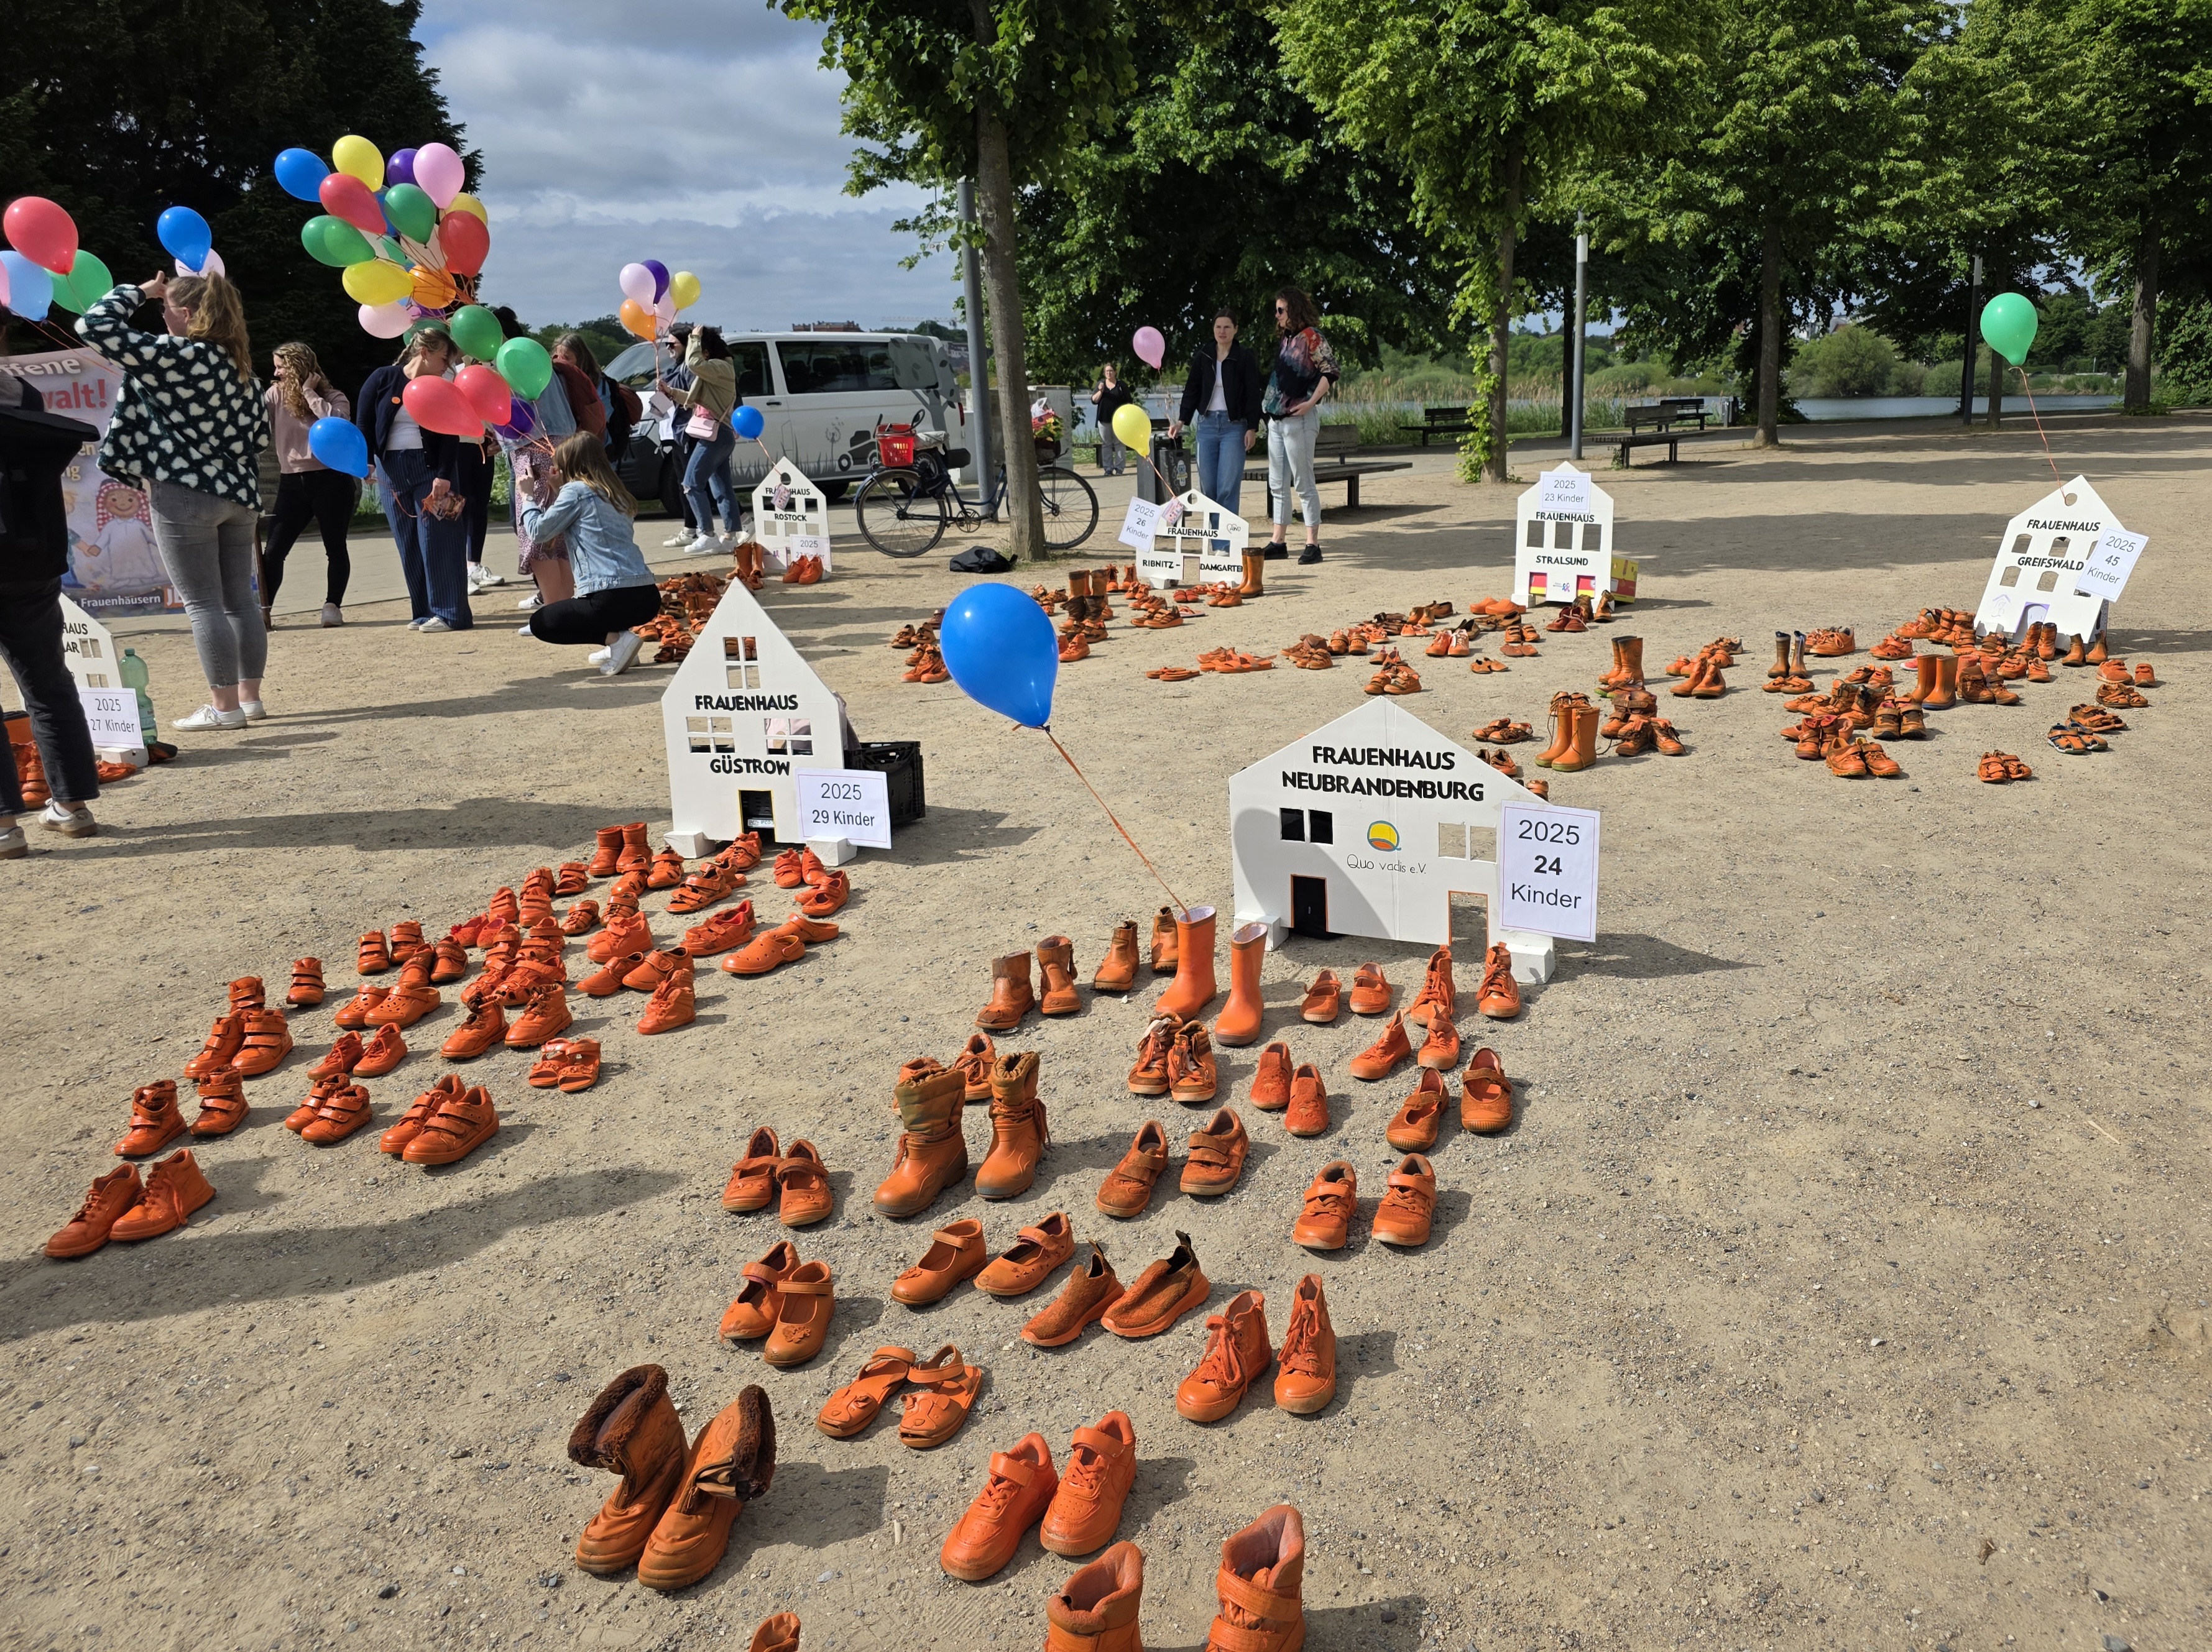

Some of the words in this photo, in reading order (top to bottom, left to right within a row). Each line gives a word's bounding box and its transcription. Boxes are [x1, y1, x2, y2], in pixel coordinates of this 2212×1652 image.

[1554, 480, 1575, 489] 2025
[1557, 494, 1584, 502] Kinder
[775, 513, 807, 521] ROSTOCK
[1135, 504, 1155, 518] 2025
[1536, 512, 1595, 523] FRAUENHAUS
[1136, 518, 1146, 526] 26
[2027, 520, 2101, 531] FRAUENHAUS
[1126, 525, 1149, 539] Kinder
[1168, 528, 1219, 538] FRAUENHAUS
[801, 540, 818, 548] 2025
[2106, 536, 2136, 552] 2025
[1143, 560, 1174, 569] RIBNITZ
[1536, 556, 1588, 566] STRALSUND
[2017, 557, 2084, 571] GREIFSWALD
[2105, 555, 2120, 566] 45
[2087, 566, 2120, 584] Kinder
[81, 595, 160, 607] Frauenhäusern
[95, 699, 121, 711] 2025
[695, 695, 798, 711] FRAUENHAUS
[90, 719, 100, 732] 27
[105, 720, 134, 732] Kinder
[1313, 746, 1455, 770] FRAUENHAUS
[710, 755, 790, 776] GÜSTROW
[821, 783, 861, 800] 2025
[1283, 769, 1483, 801] NEUBRANDENBURG
[813, 810, 829, 824] 29
[834, 811, 874, 826] Kinder
[1519, 820, 1579, 845] 2025
[1347, 855, 1374, 869] Quo
[1379, 860, 1406, 873] vadis
[1534, 855, 1562, 875] 24
[1512, 883, 1581, 909] Kinder
